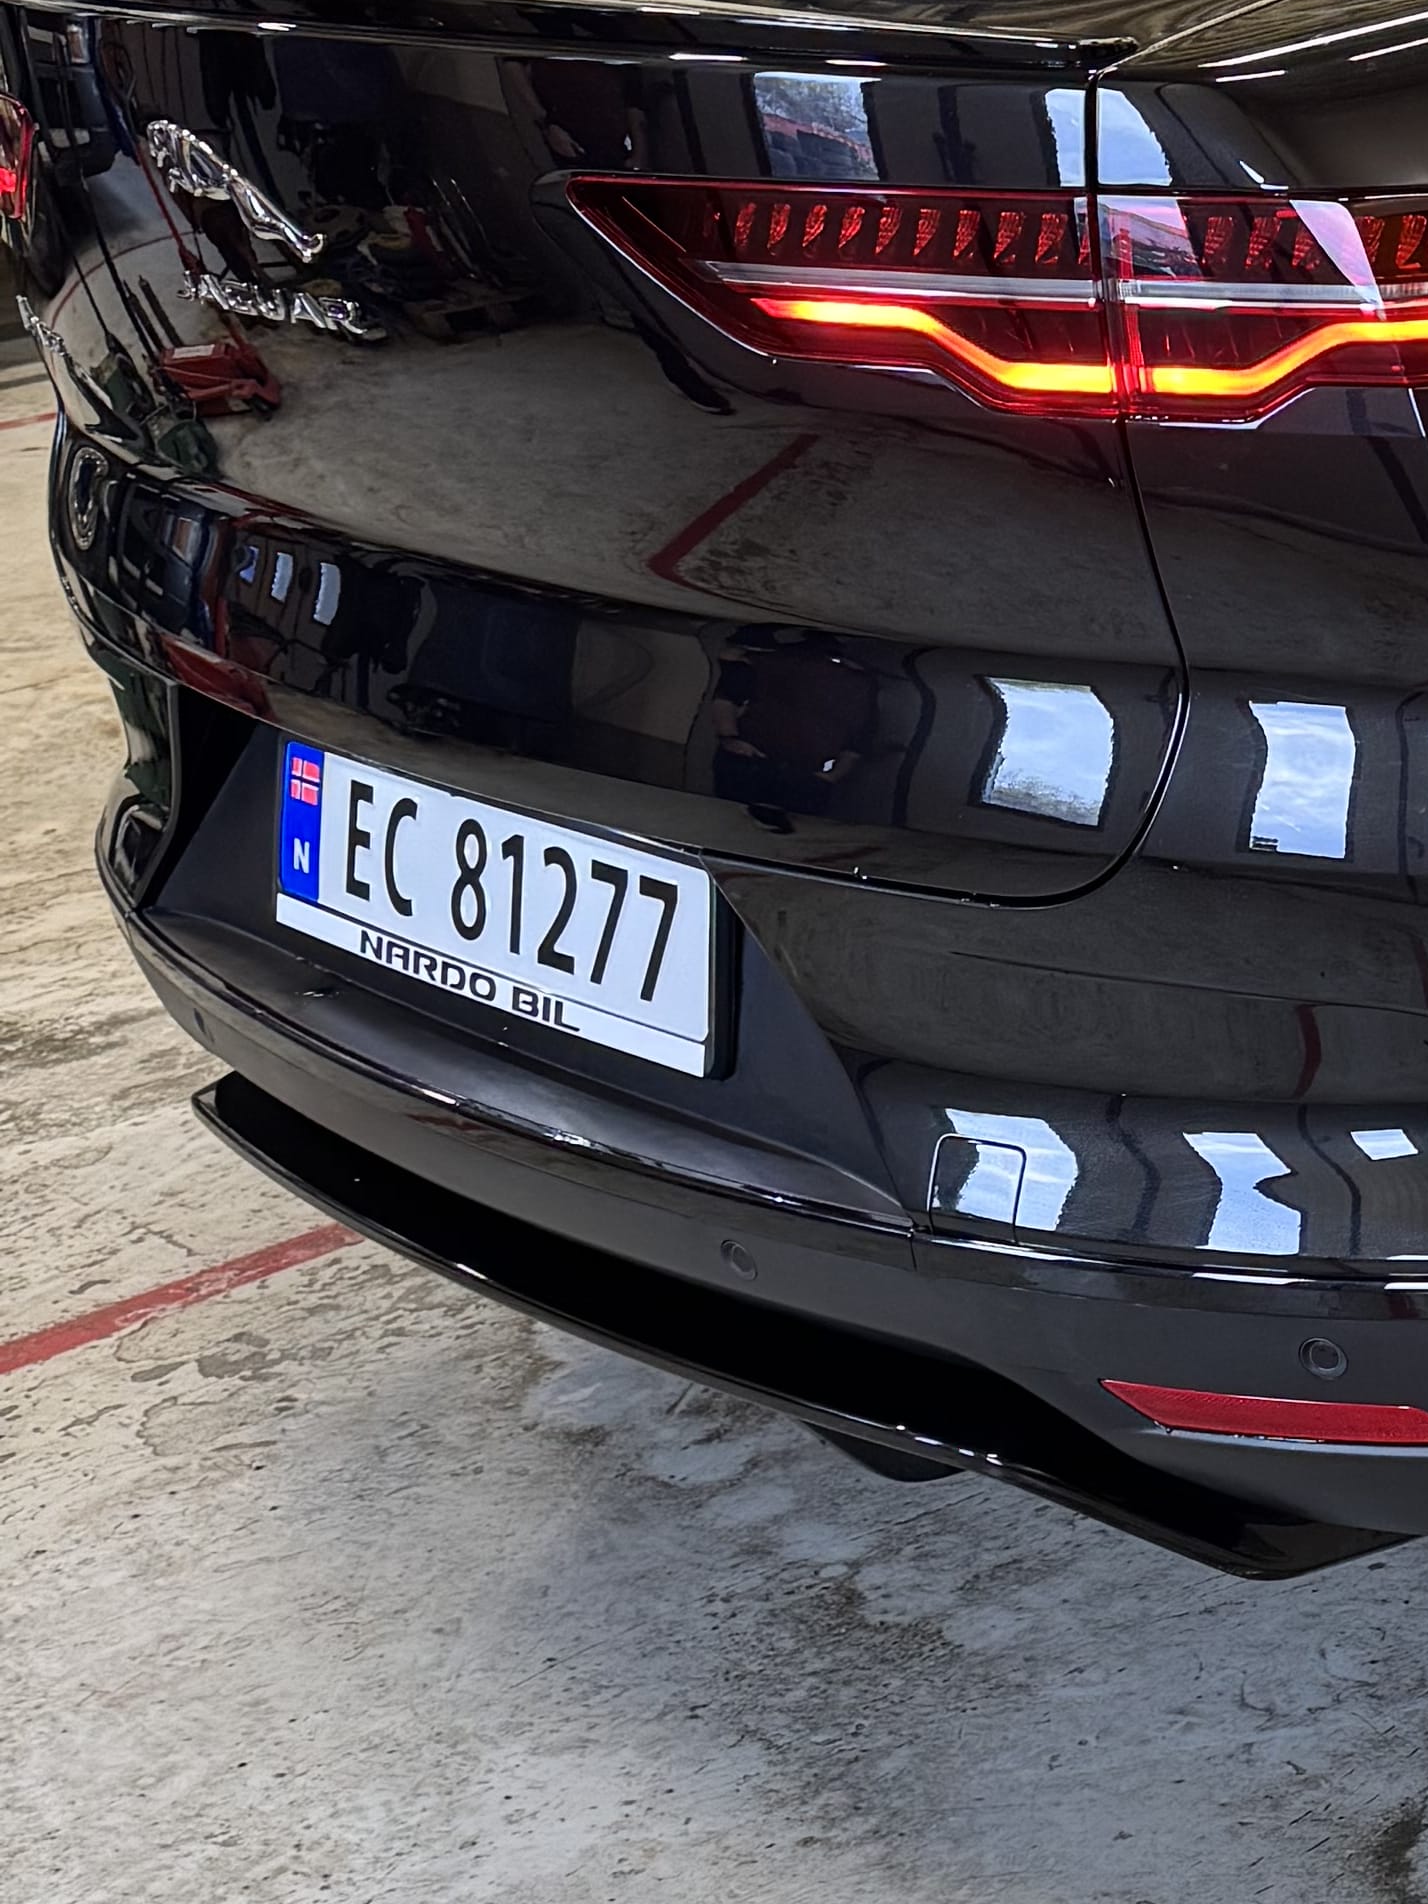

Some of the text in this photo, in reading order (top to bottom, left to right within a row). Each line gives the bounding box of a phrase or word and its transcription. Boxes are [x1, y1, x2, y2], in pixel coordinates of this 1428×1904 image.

[293, 837, 311, 875] N
[345, 779, 679, 1002] EC 81277
[360, 928, 580, 1034] NARDO BIL
